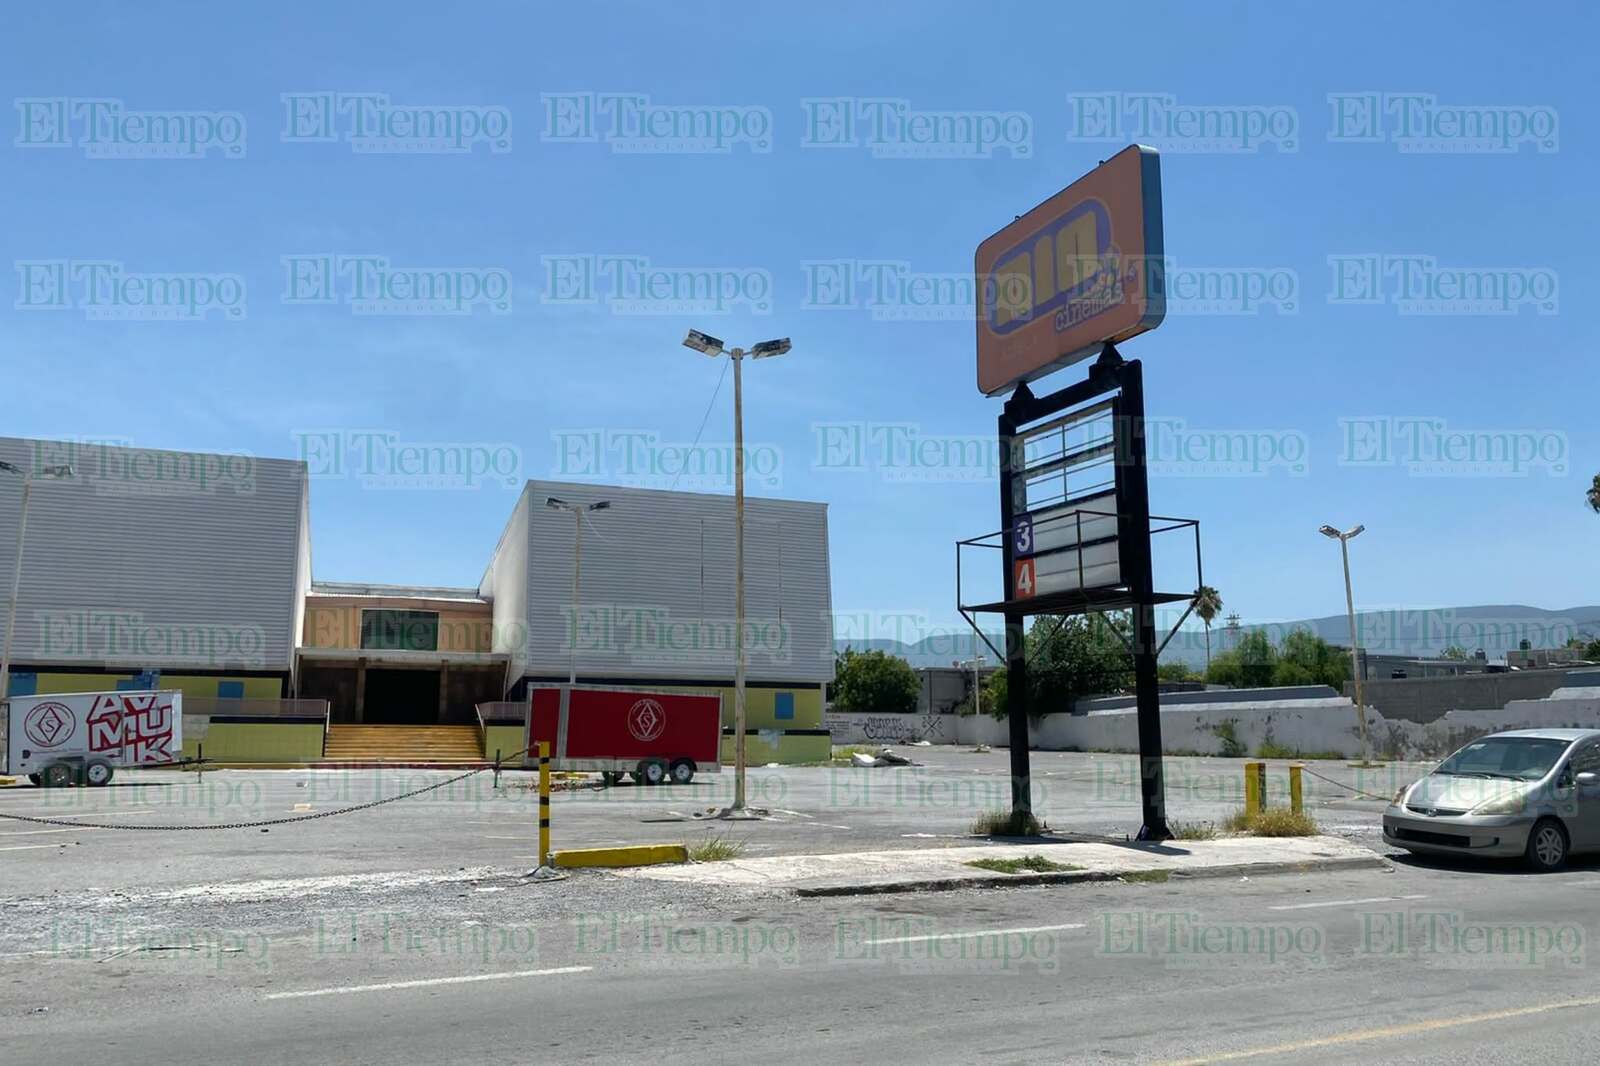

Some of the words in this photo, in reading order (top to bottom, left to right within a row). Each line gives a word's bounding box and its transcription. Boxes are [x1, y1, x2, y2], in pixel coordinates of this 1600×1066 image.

[1016, 521, 1031, 552] 3
[1018, 563, 1032, 594] 4
[45, 719, 56, 733] S
